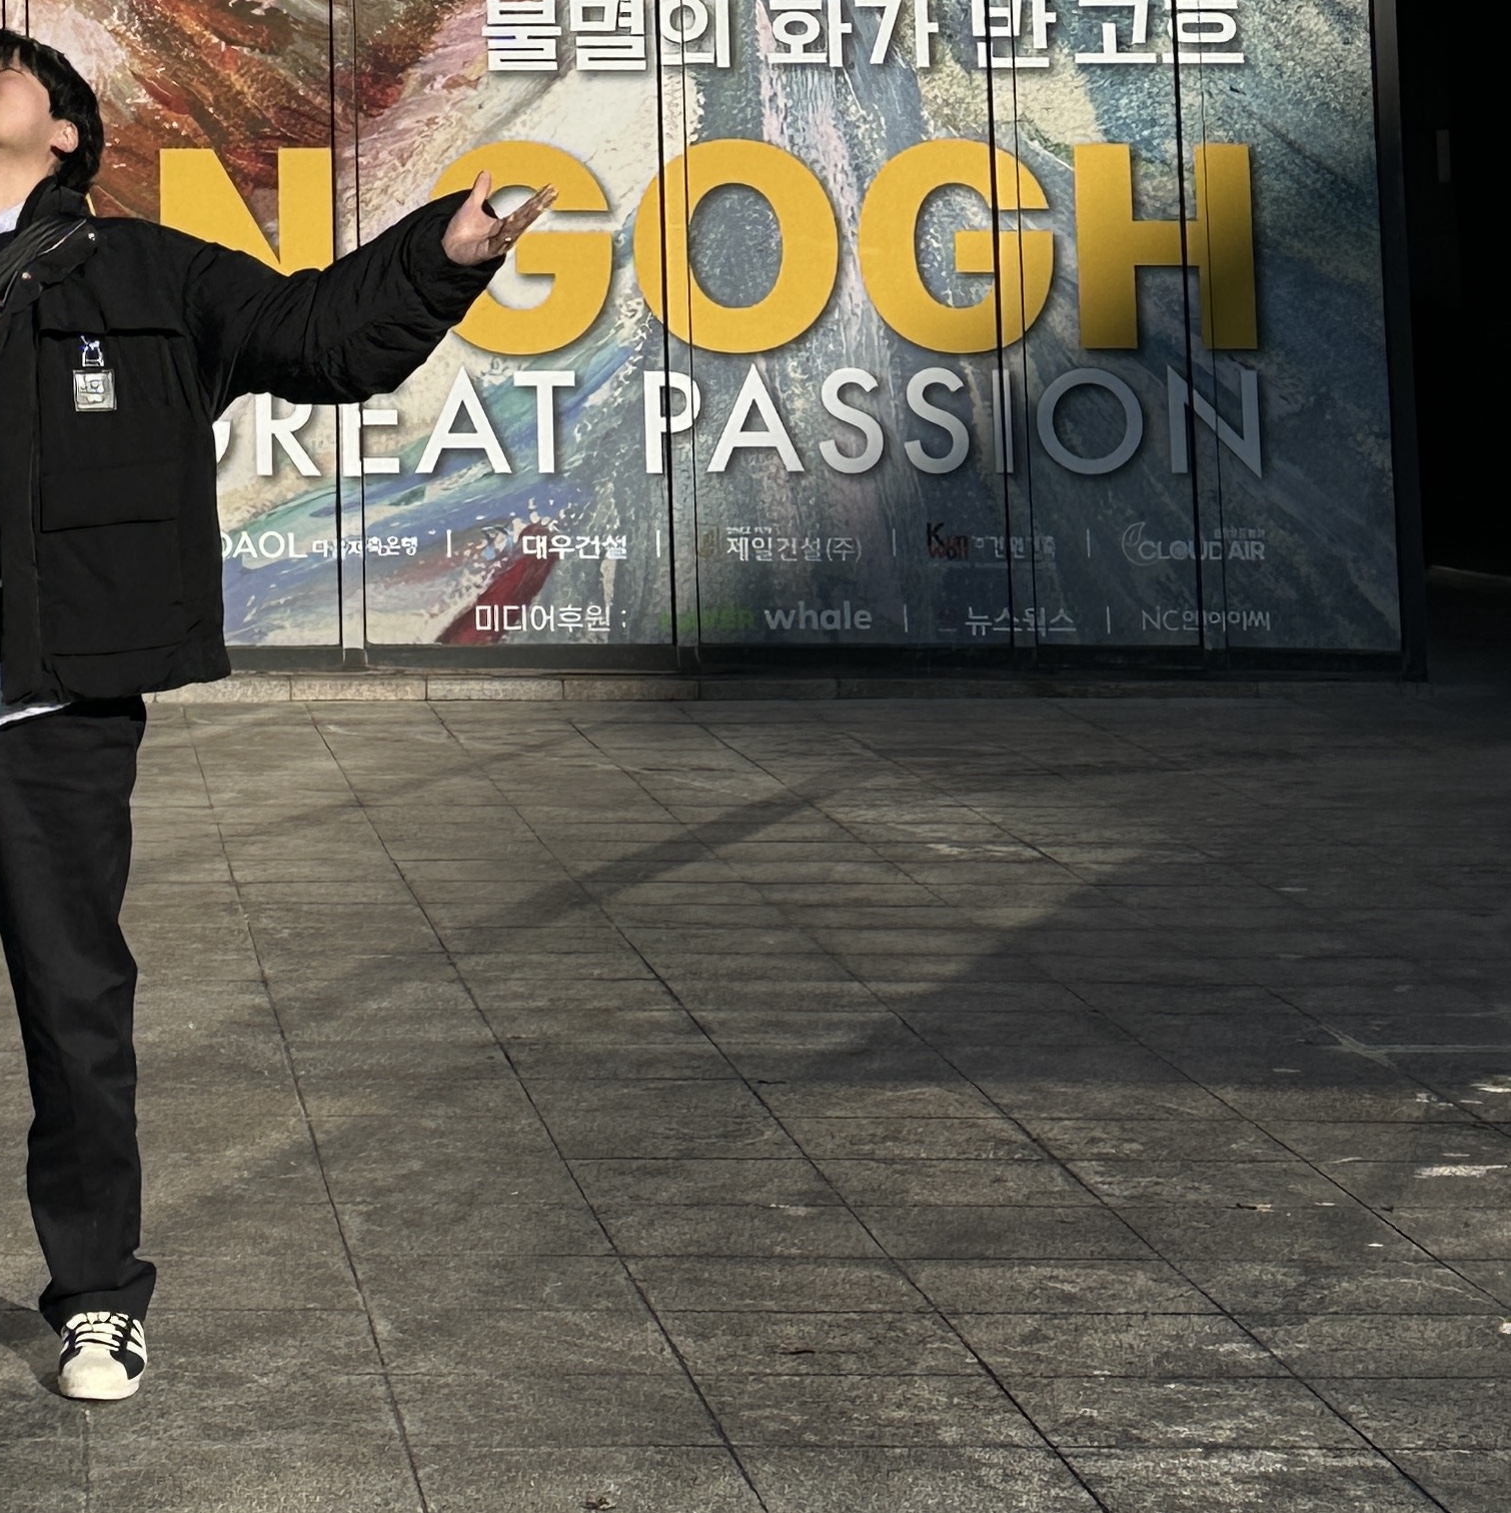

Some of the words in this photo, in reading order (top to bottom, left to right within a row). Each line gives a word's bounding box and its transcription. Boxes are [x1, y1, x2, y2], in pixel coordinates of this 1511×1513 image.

[430, 138, 1258, 355] GOGH
[213, 362, 576, 477] REAT
[642, 362, 1263, 478] PASSION
[522, 534, 628, 560] 대우건설
[475, 604, 611, 633] 미디어후원
[763, 600, 873, 631] whale
